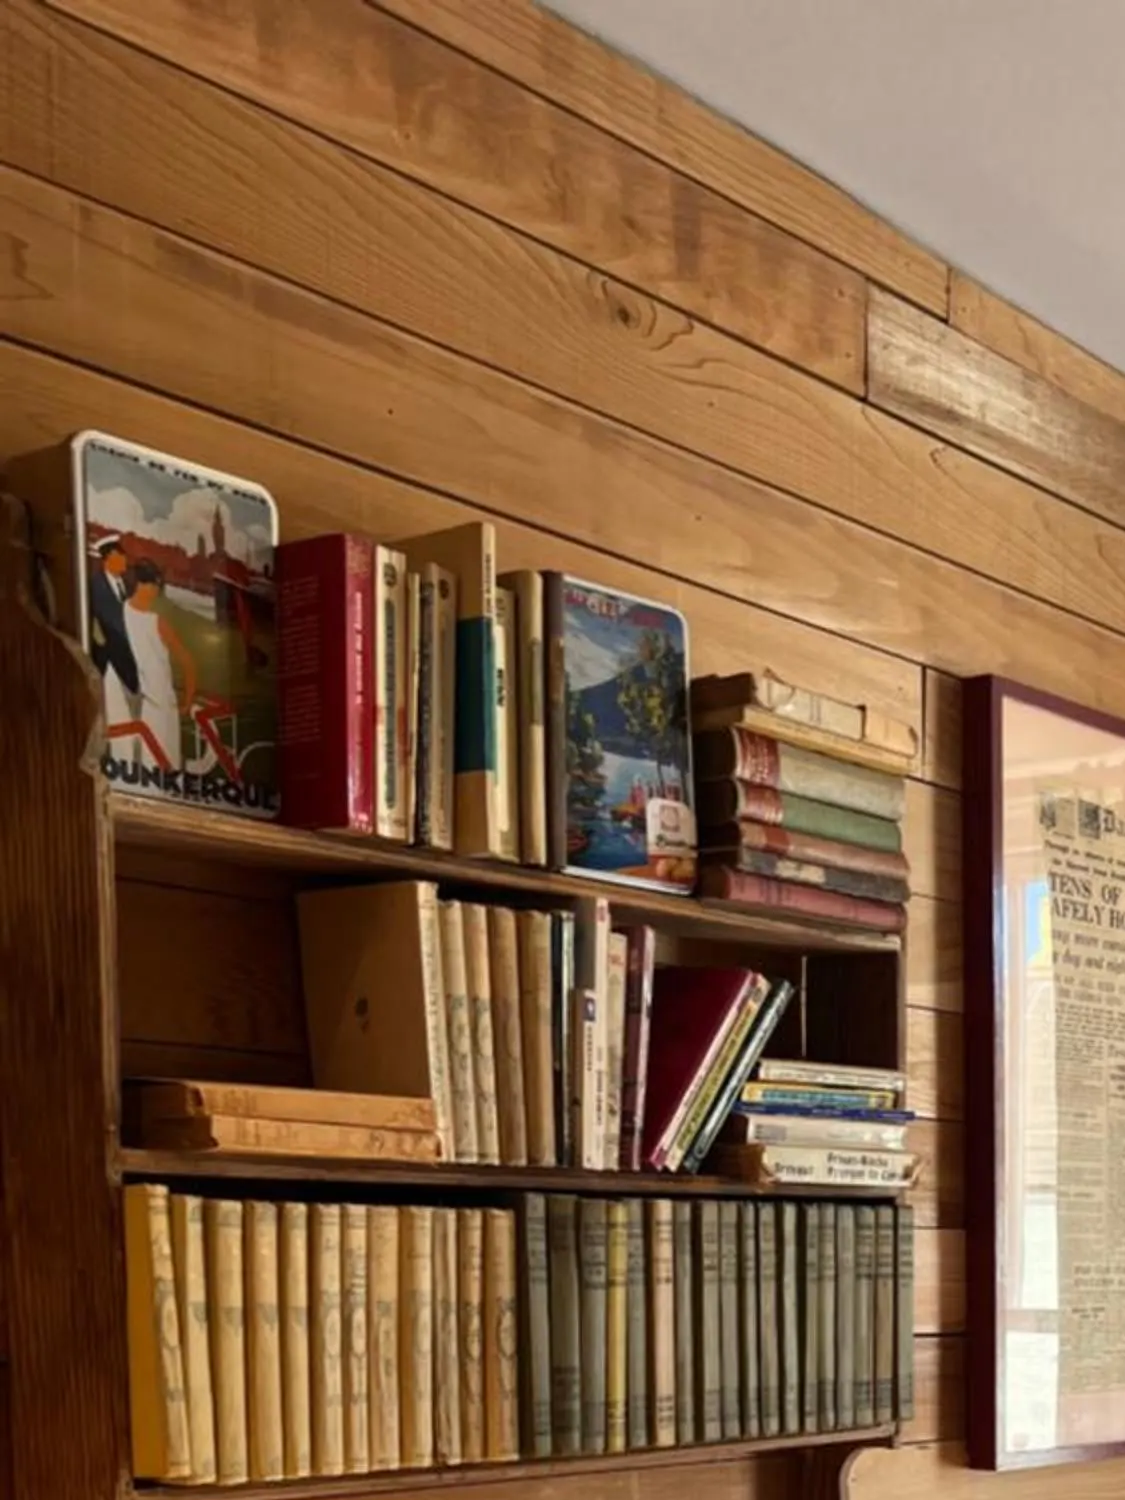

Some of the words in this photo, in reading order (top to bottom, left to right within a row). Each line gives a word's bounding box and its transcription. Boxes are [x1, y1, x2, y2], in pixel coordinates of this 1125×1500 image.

[1049, 871, 1093, 897] TENS
[1101, 883, 1121, 907] OF
[1053, 897, 1103, 926] AFELY
